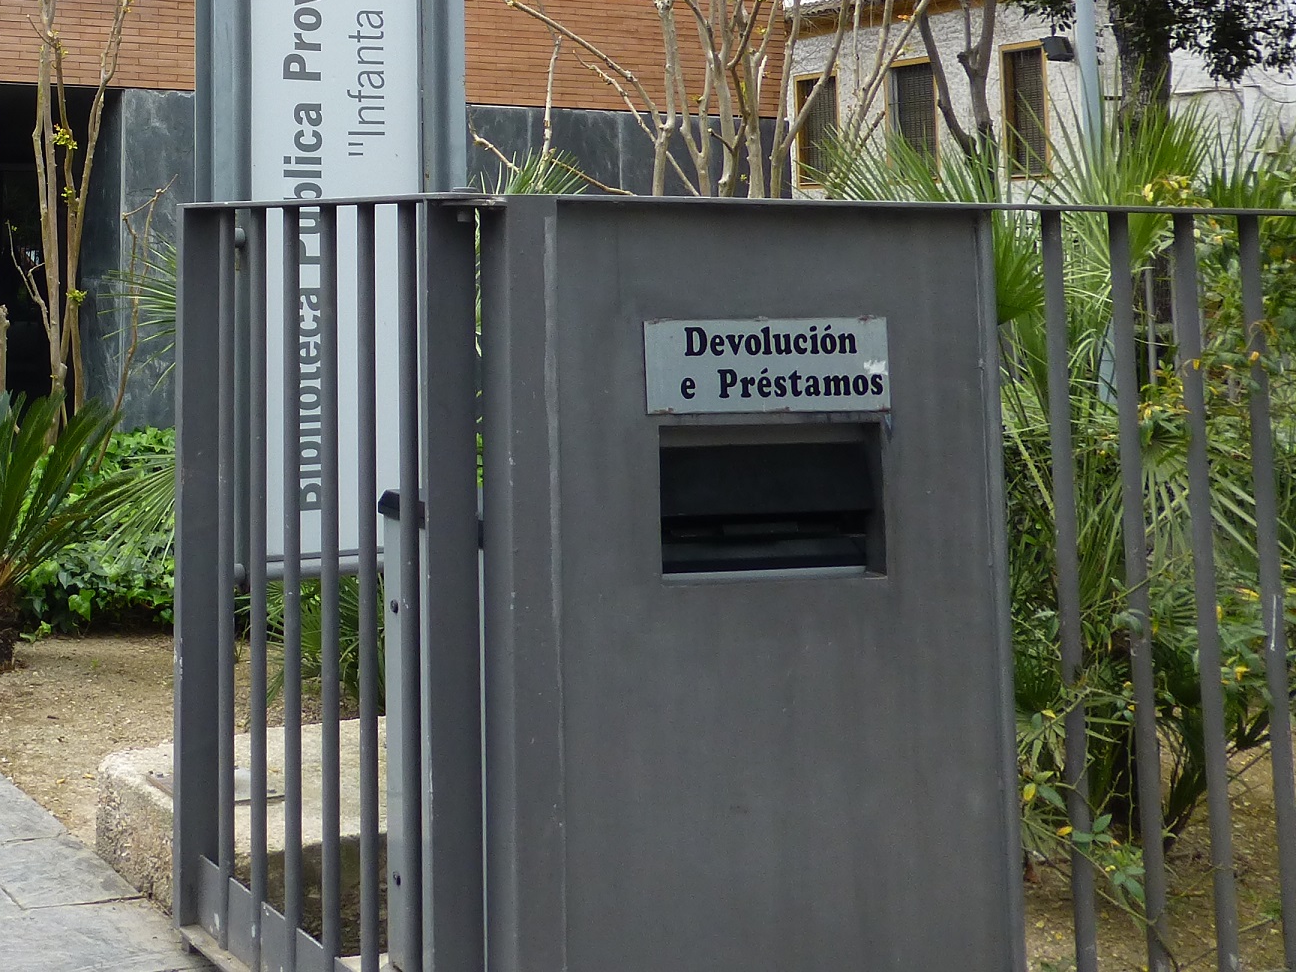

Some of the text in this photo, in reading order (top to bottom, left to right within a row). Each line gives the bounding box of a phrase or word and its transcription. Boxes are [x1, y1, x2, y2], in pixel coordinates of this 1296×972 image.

[346, 9, 386, 157] "Infanta
[683, 324, 858, 357] Devolución
[680, 367, 884, 399] e Préstamos
